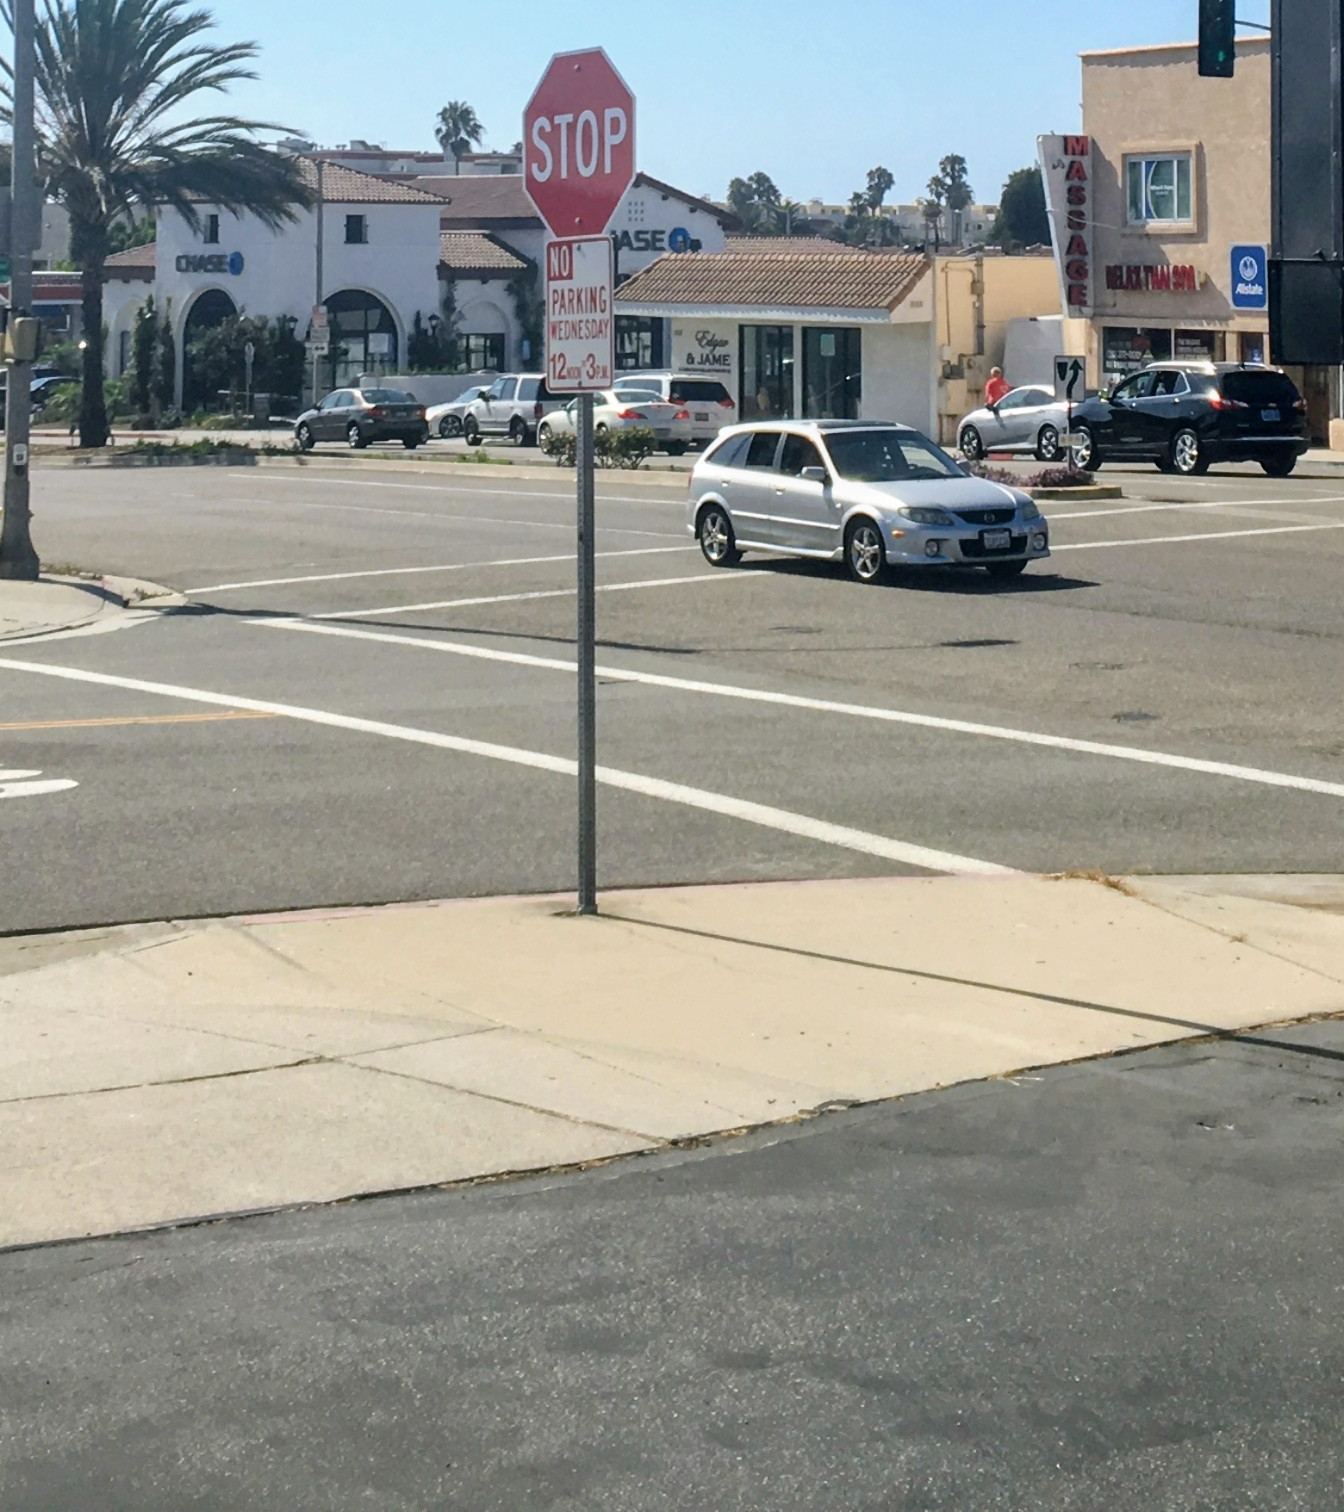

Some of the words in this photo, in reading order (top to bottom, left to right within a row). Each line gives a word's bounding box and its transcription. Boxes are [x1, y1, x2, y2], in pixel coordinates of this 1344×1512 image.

[531, 107, 627, 182] STOP
[1064, 136, 1088, 306] MASSAGE
[611, 230, 666, 251] ASE
[176, 254, 227, 273] CHASE
[550, 245, 569, 278] NO
[552, 285, 607, 316] PARKING
[550, 318, 609, 341] WEDNESDAY
[550, 352, 567, 380] 12
[586, 352, 596, 380] 3
